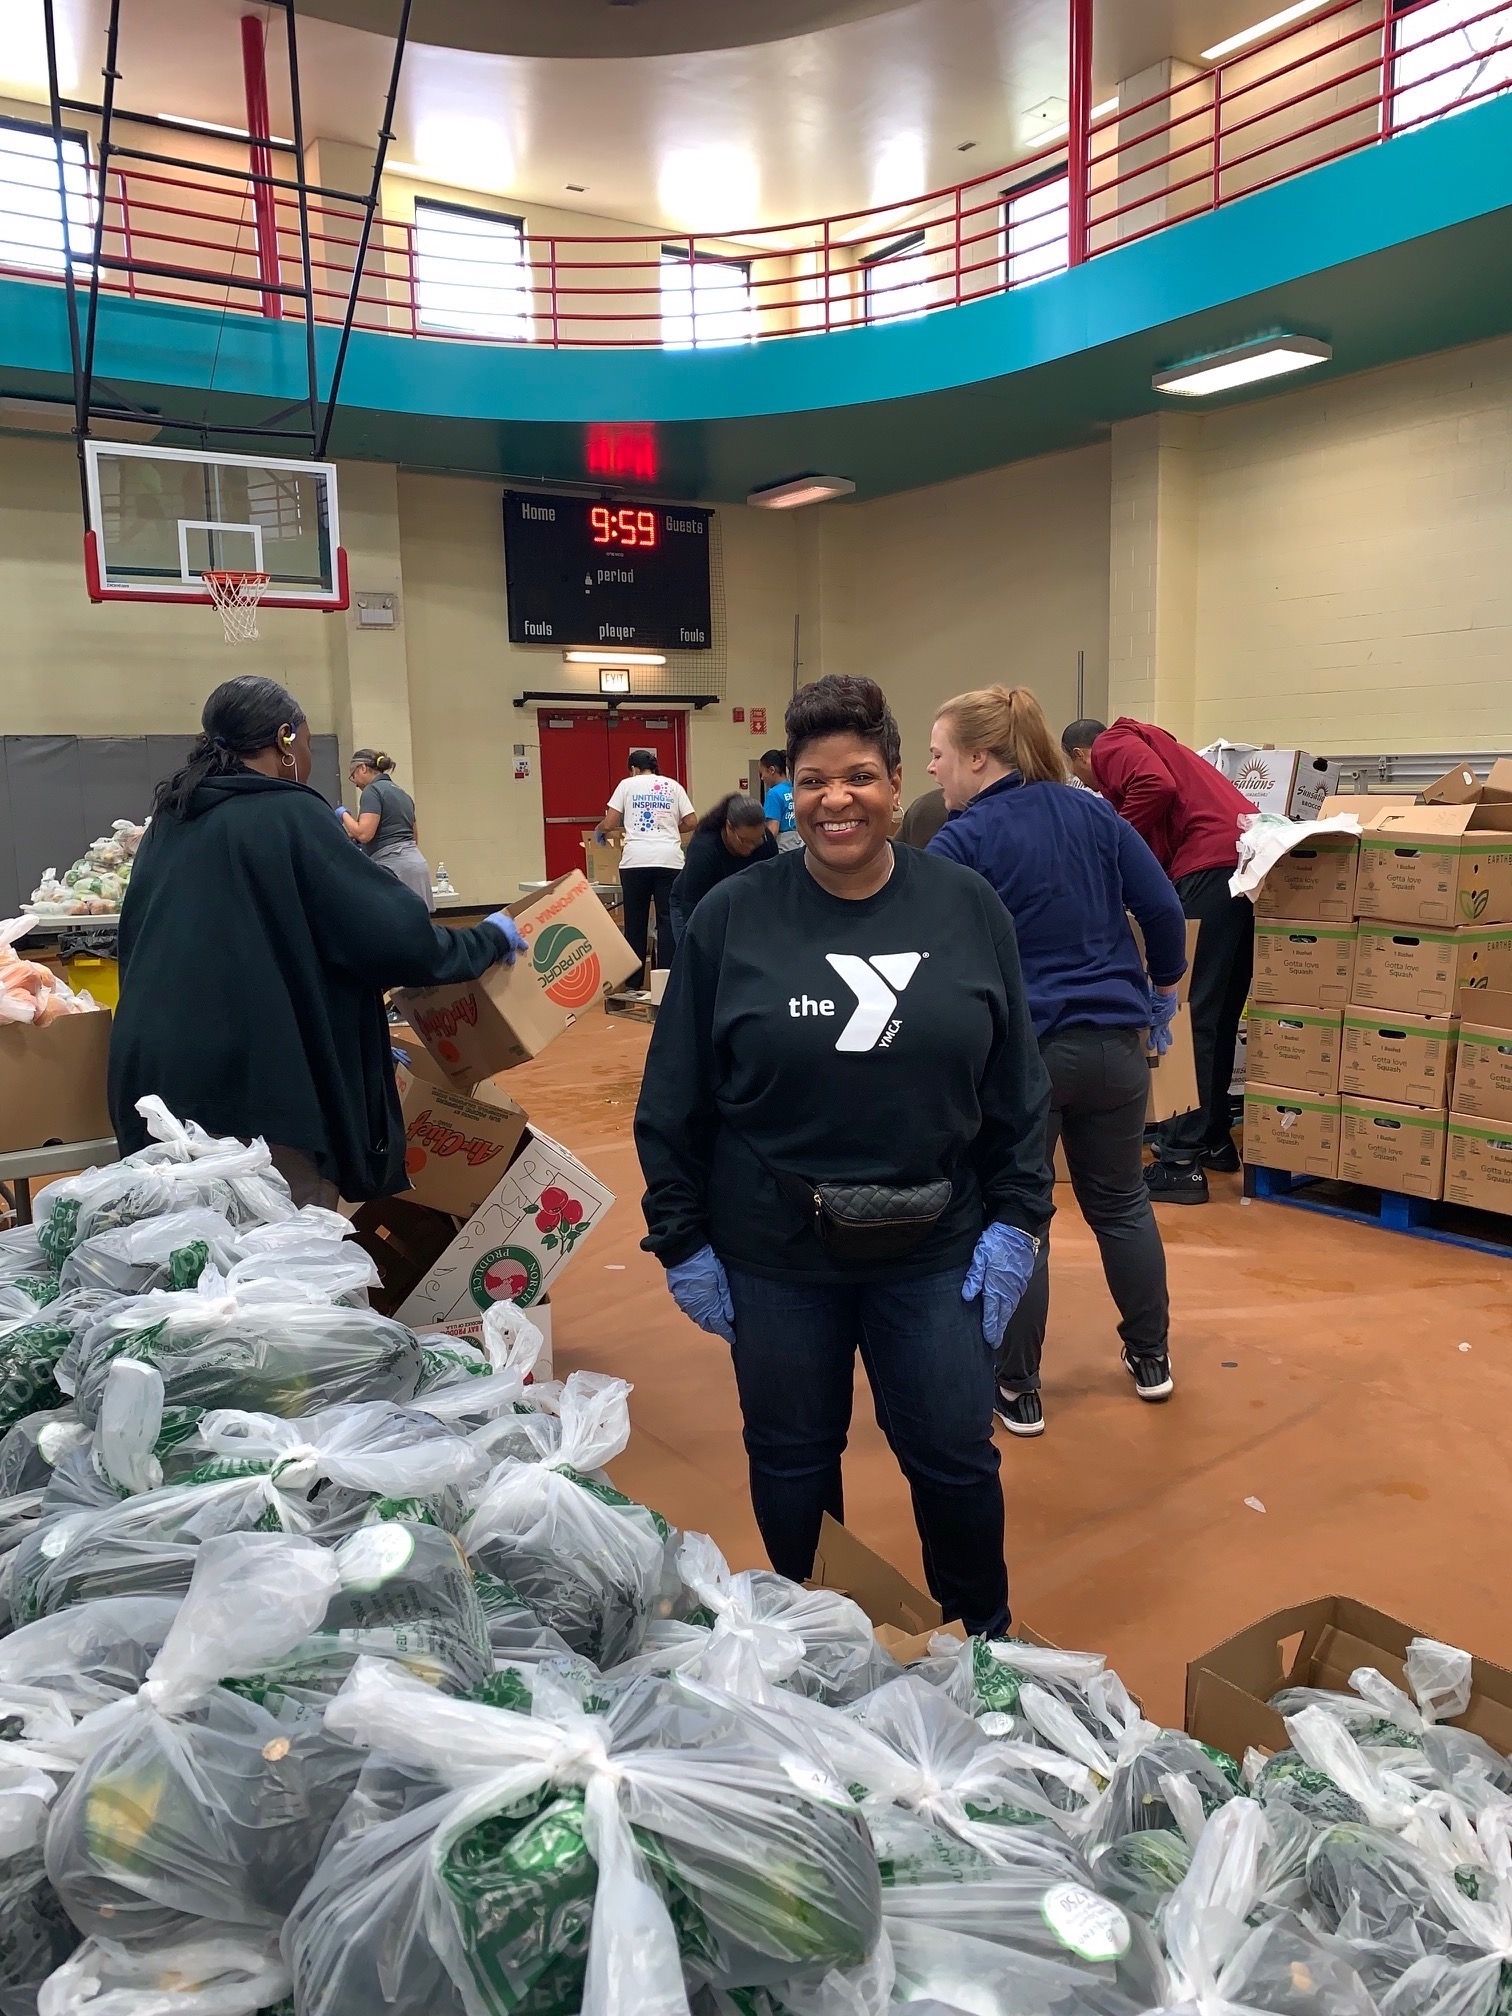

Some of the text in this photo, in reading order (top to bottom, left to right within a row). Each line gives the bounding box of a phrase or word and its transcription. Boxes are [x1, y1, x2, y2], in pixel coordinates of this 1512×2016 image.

[522, 503, 556, 522] Home
[591, 506, 655, 546] 9:59
[665, 515, 703, 534] Guests
[597, 568, 634, 585] period
[524, 620, 553, 636] fouls
[599, 622, 636, 641] player
[680, 627, 705, 642] fouls
[632, 794, 665, 802] UNITING
[1297, 785, 1326, 803] Sunsatio
[632, 801, 671, 810] INSPIRING
[1301, 800, 1321, 811] BROCCO
[1386, 873, 1422, 885] Gotta love
[1391, 882, 1416, 891] Squash
[1283, 959, 1320, 969] Gotta love
[1384, 960, 1420, 972] Gotta love
[1289, 967, 1314, 976] Squash
[1389, 969, 1414, 979] Squash
[789, 994, 835, 1018] the
[878, 1018, 903, 1049] YMCA
[1273, 1043, 1306, 1055] Gotta love
[1278, 1051, 1301, 1060] Squash
[1371, 1054, 1408, 1067] Gotta love
[1376, 1062, 1402, 1074] Squash
[1271, 1128, 1305, 1141] Gotta love
[1276, 1137, 1300, 1147] Squash
[1368, 1143, 1404, 1156] Gotta love
[1372, 1151, 1398, 1163] Squash
[1480, 1164, 1503, 1176] Gotta
[472, 1248, 510, 1293] PRODUCE
[520, 1262, 539, 1303] NORTH
[467, 1326, 480, 1335] BAY
